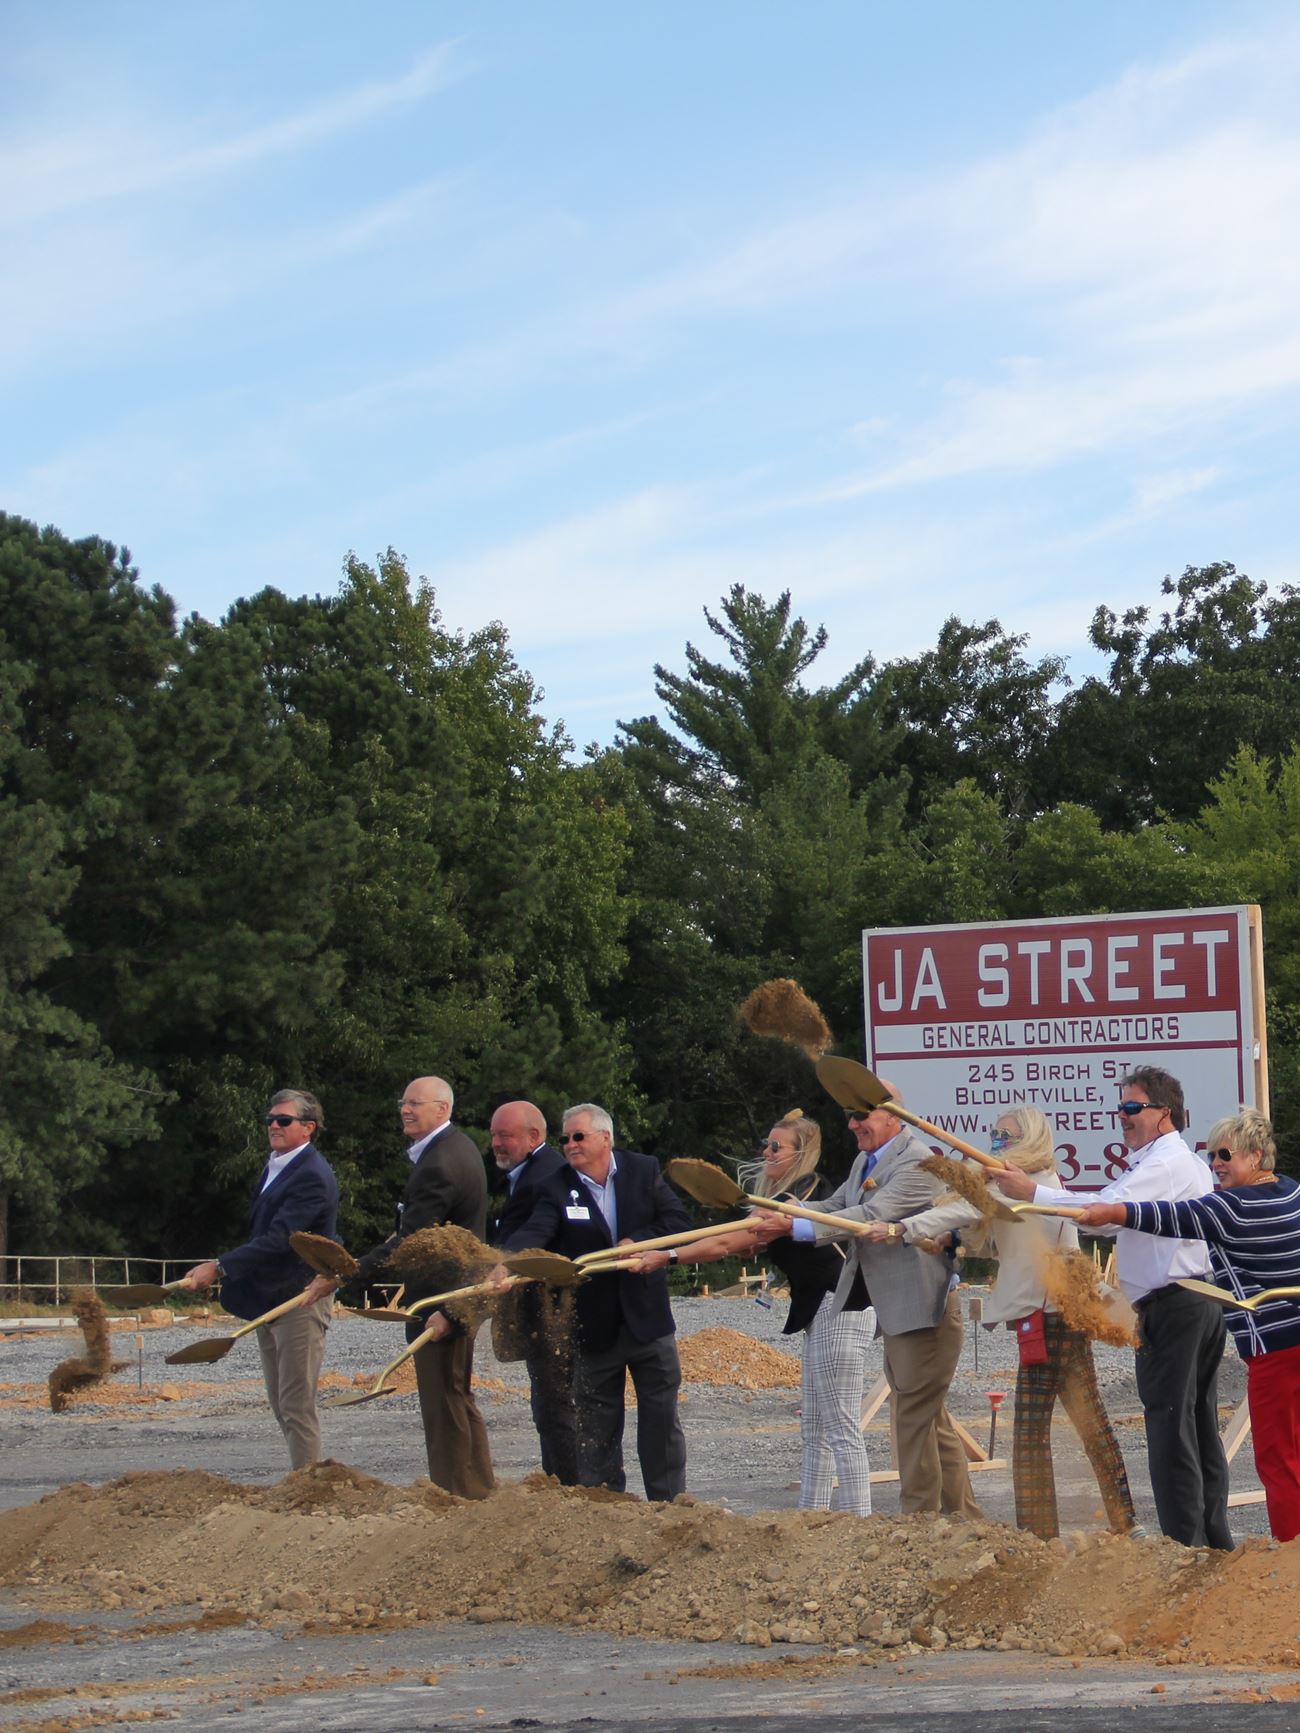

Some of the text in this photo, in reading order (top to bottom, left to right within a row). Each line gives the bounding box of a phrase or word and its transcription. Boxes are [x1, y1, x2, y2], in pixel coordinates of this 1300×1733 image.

[877, 930, 1229, 1012] JA STREET
[923, 1016, 1180, 1049] GENERAL CONTRACTORS
[968, 1064, 1015, 1083] 245
[1026, 1062, 1091, 1081] BIRCH
